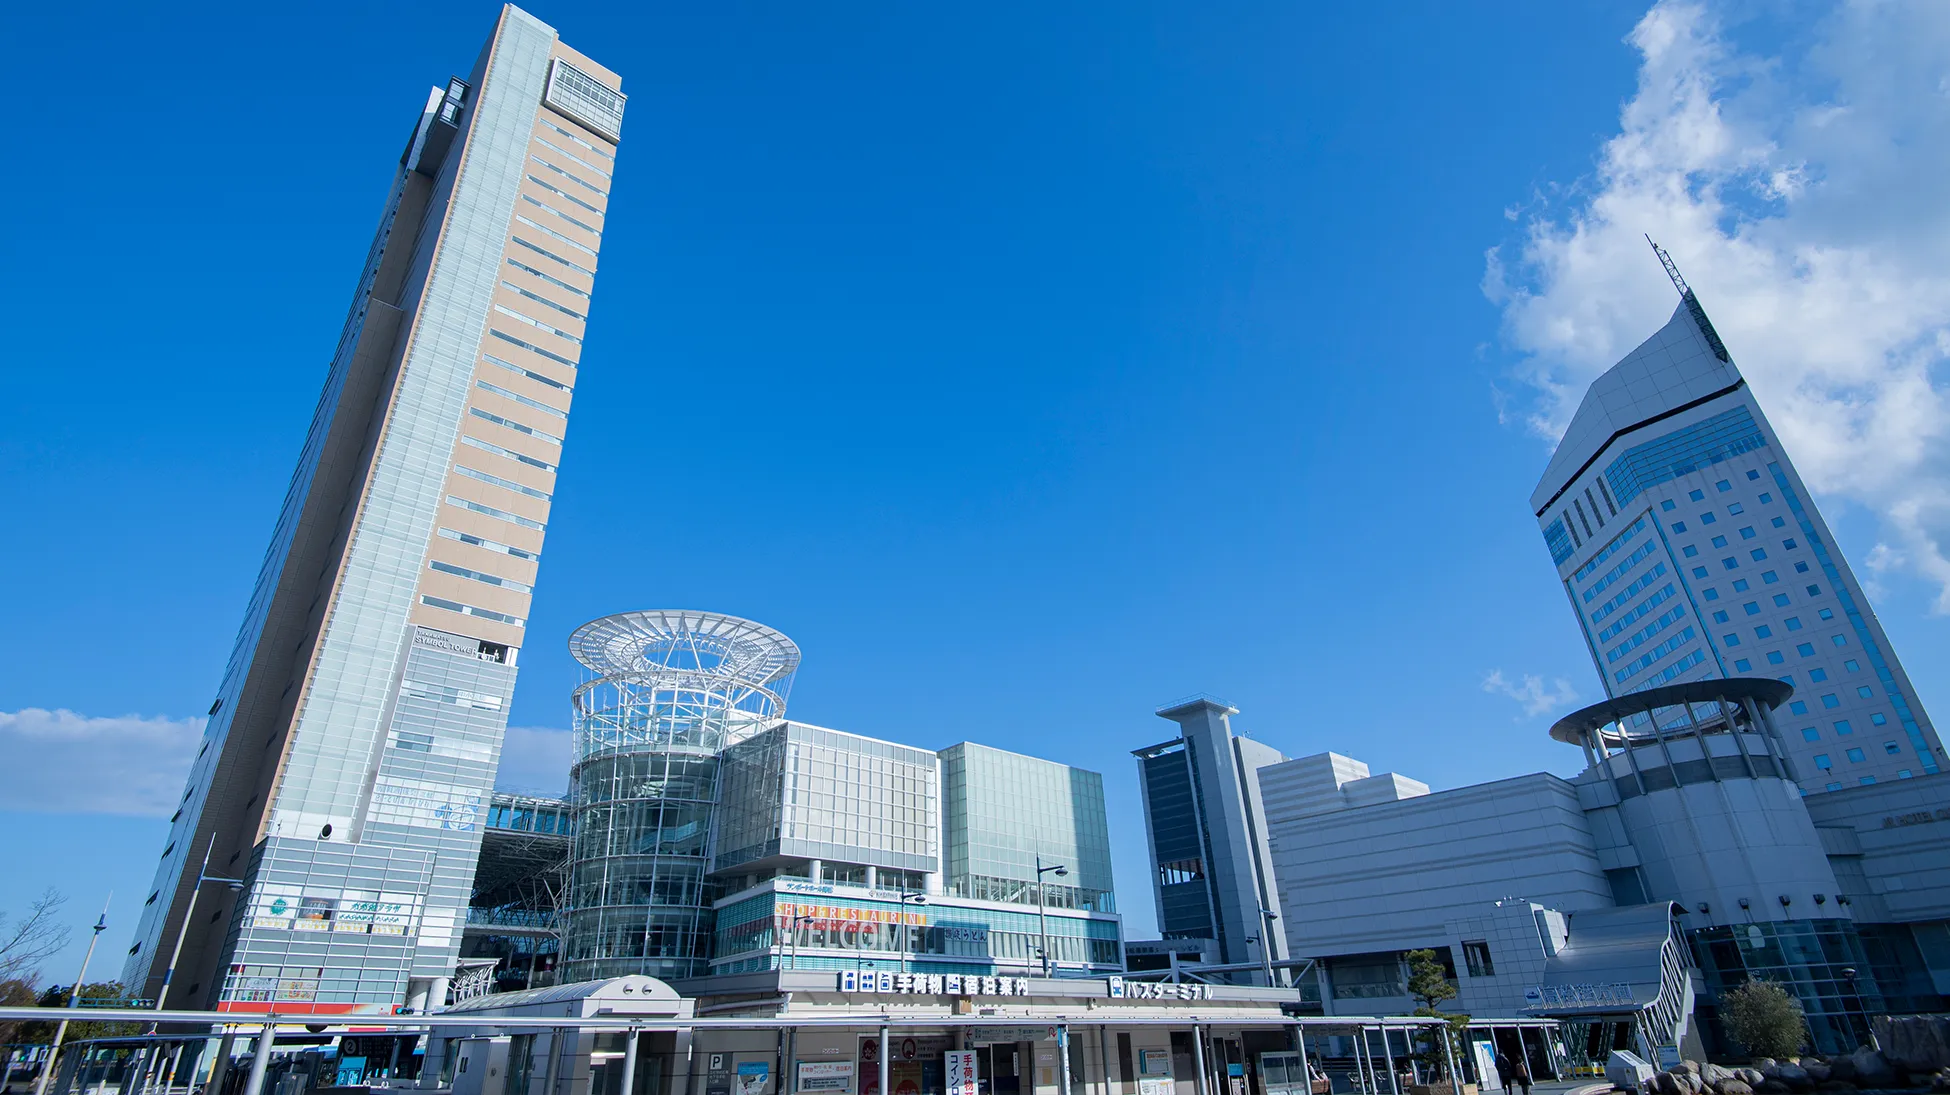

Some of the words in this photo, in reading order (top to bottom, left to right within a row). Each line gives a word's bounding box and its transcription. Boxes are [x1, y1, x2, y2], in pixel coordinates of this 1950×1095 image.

[414, 636, 448, 649] SYMBOL
[449, 643, 478, 657] TOWER
[1895, 812, 1933, 826] HOTEL
[775, 904, 926, 925] SHOP&RESTAURANT
[774, 917, 920, 951] WELCOME
[945, 928, 987, 942] 讃岐うどん
[897, 973, 943, 994] 手荷物
[964, 975, 1028, 996] 宿泊案内
[1125, 981, 1214, 1000] バスターミナル
[347, 1041, 354, 1051] 2
[712, 1056, 721, 1068] P
[950, 1055, 959, 1095] コインロ
[963, 1054, 974, 1095] 手荷物
